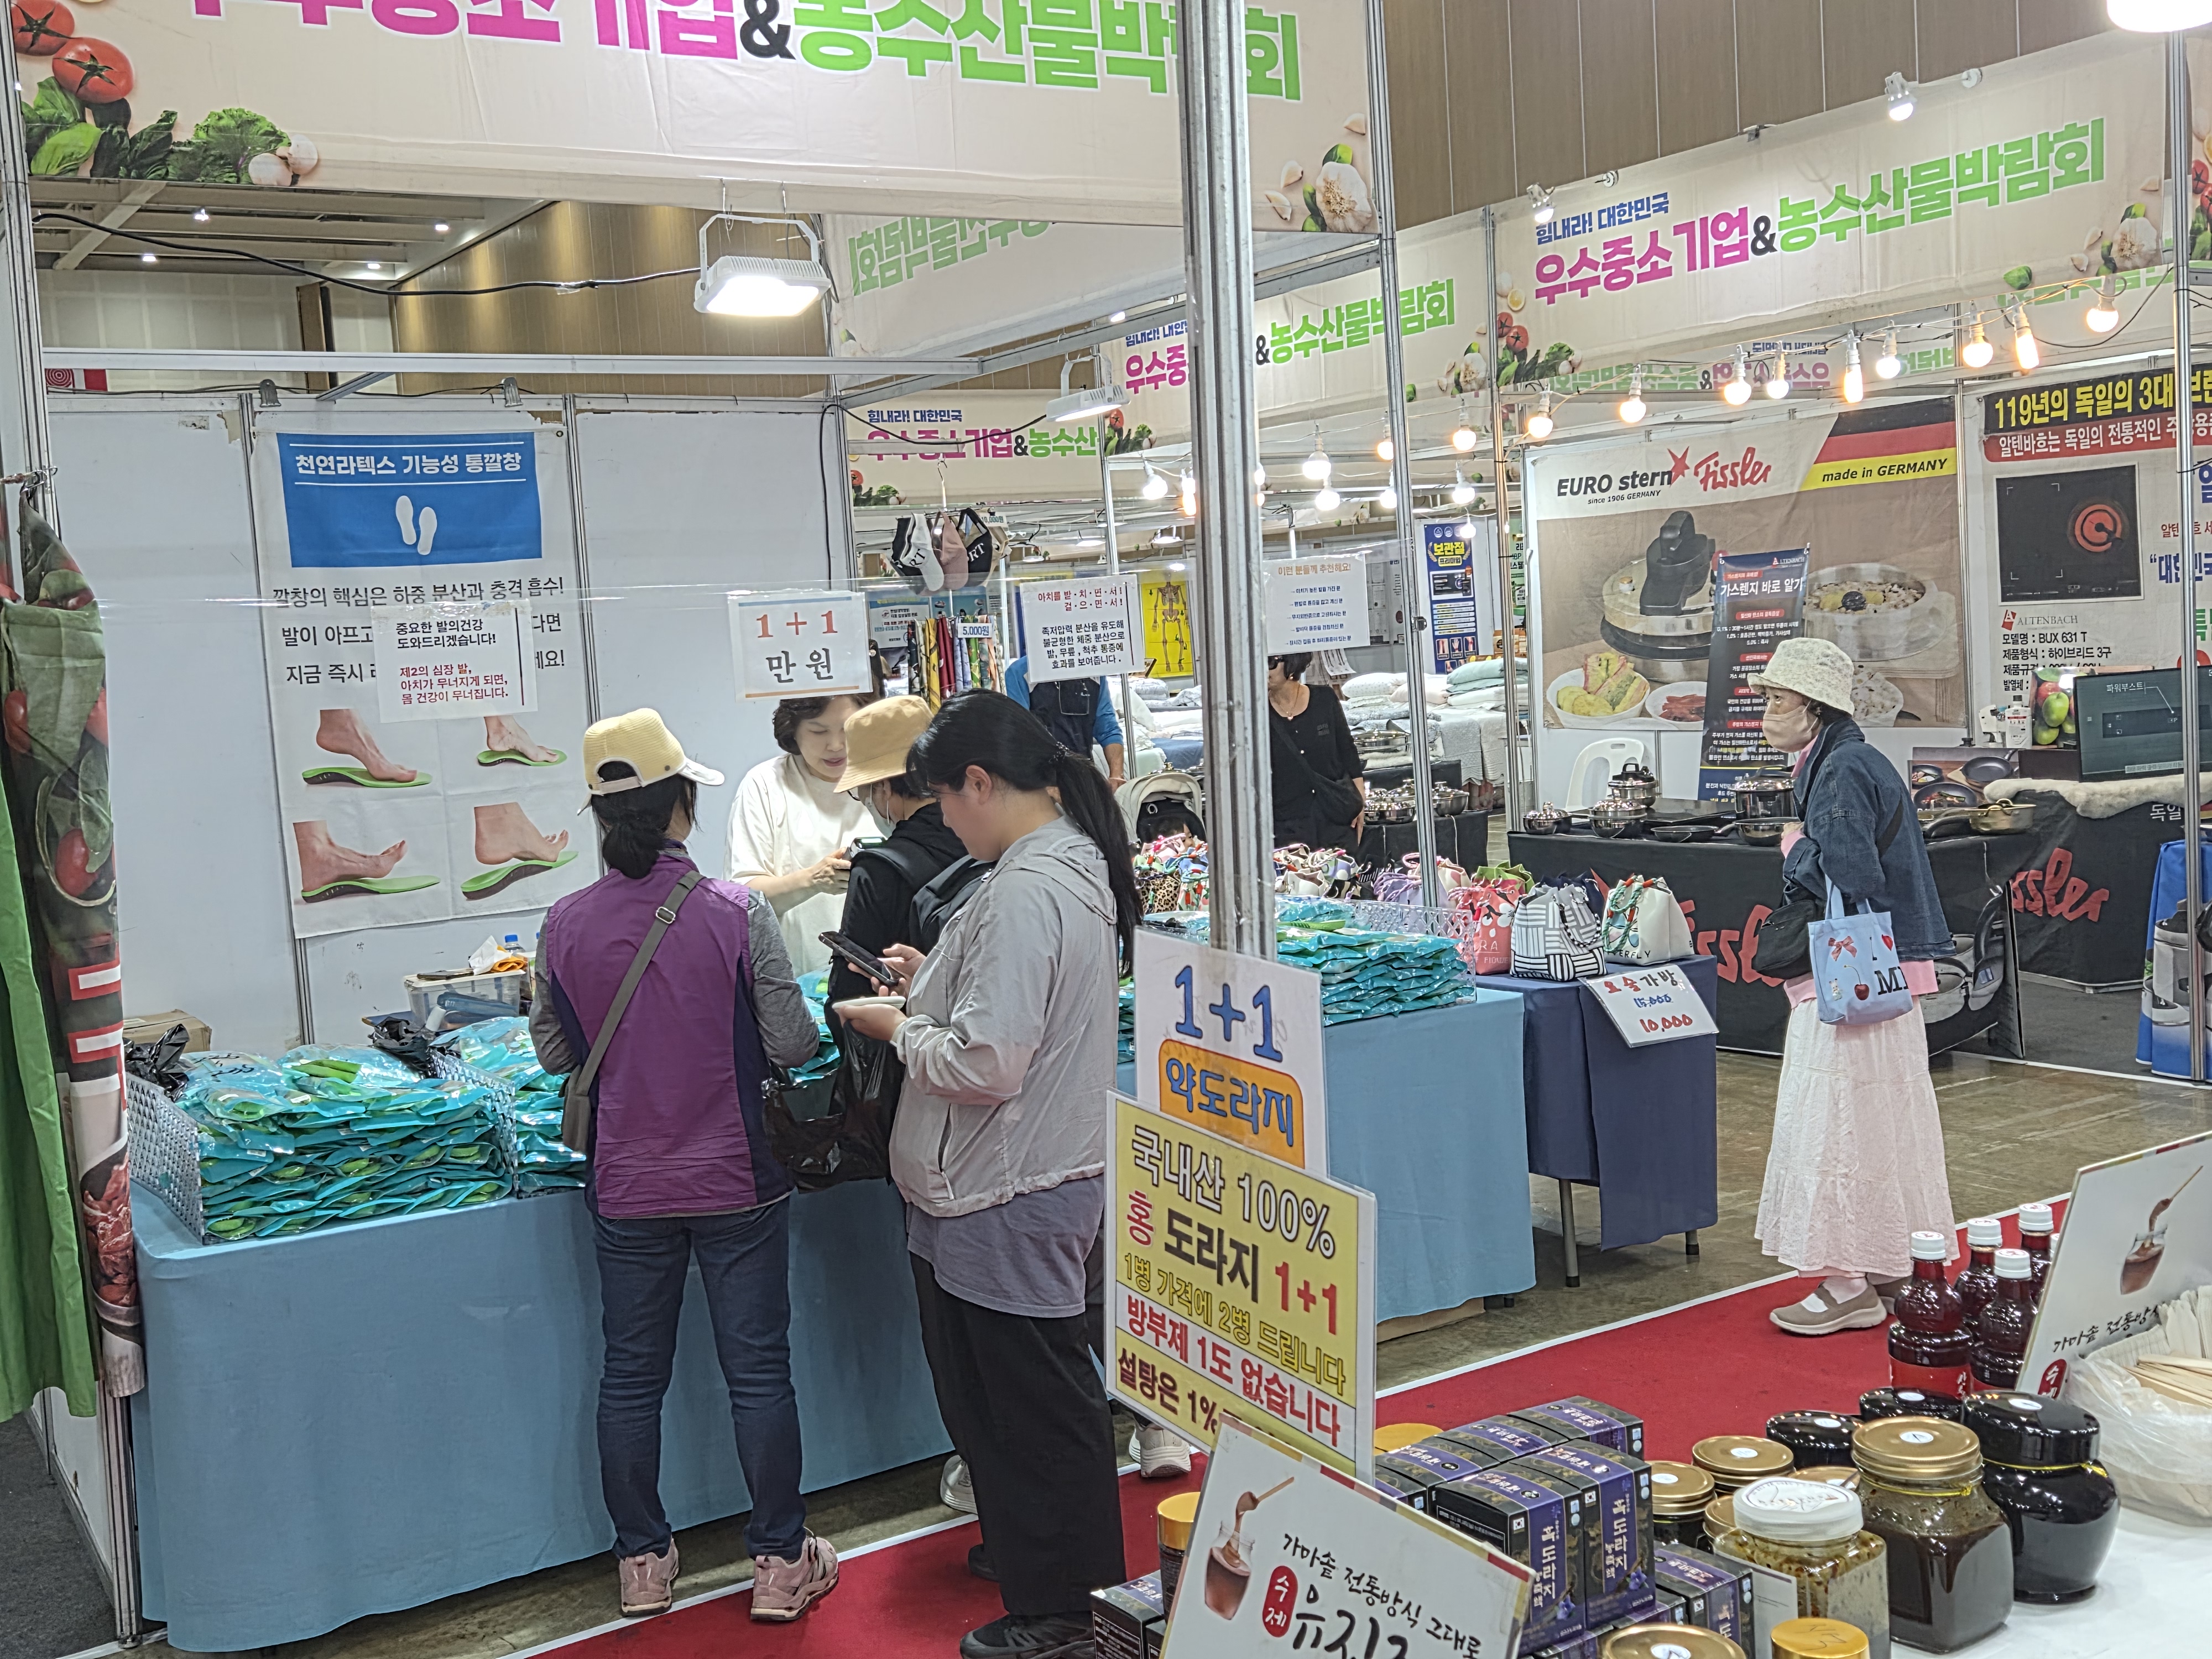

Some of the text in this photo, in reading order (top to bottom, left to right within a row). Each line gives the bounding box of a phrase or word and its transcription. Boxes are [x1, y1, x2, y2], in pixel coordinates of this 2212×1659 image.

[1536, 191, 1669, 245] 힘내라! 대한민국
[1995, 389, 2068, 429] 119년의
[2075, 379, 2132, 418] 독일의
[2140, 373, 2173, 410] 3대
[868, 410, 962, 422] 힘내라! 대한민국
[1999, 432, 2060, 458] 알텐바흐는
[2065, 425, 2104, 450] 독일의
[2109, 418, 2161, 446] 전통적인
[295, 452, 521, 475] 천연라텍스 기능성 통깔창
[1694, 446, 1772, 492] Fissler
[1822, 457, 1948, 483] made in GERMANY
[1557, 470, 1673, 497] EURO stern
[1608, 494, 1625, 503] 1906
[1627, 490, 1661, 500] GERMANY
[1279, 566, 1293, 576] 이런
[273, 577, 564, 608] 깔창의 핵심은 하중 분산과 충격 흡수!
[1038, 591, 1061, 602] 아치를
[1720, 577, 1803, 597] 가스렌지 바로 알기
[396, 622, 432, 636] 중요한
[1042, 620, 1124, 636] 족저압력 분산을 유도해
[2017, 615, 2078, 625] ALTENBACH
[283, 626, 317, 646] 발이
[397, 633, 496, 650] 도와드리겠습니다!
[1044, 632, 1125, 648] 불균형한 체중 분산으로
[2002, 632, 2087, 645] 모델명 BUX 631 T
[1083, 645, 1098, 654] 척추
[1100, 643, 1123, 653] 통증에
[2003, 647, 2111, 660] 제품형식 하이브리드 3구
[400, 663, 472, 677] 제2의 심장 발,
[1052, 659, 1075, 669] 효과를
[286, 664, 363, 685] 지금 즉시
[401, 674, 508, 691] 아치가 무너지게 되면,
[2004, 680, 2023, 691] 발열체
[2106, 681, 2144, 693] 파워부스트
[401, 688, 509, 705] 몸 건강이 무너집니다.
[2150, 804, 2182, 822] 독일
[2009, 848, 2109, 922] ssler
[1175, 965, 1283, 1062] 1+1
[1640, 1014, 1693, 1032] 10,000
[1166, 1058, 1293, 1147] 약도라지
[1131, 1124, 1336, 1259] 국내산 100%
[1126, 1190, 1338, 1336] 홍 도라지 1+1
[1124, 1253, 1346, 1395] 1병 가격에 2병 드립니다
[1126, 1295, 1340, 1448] 방부제 1도 없습니다
[1118, 1347, 1218, 1434] 설탕은 1%
[1344, 1567, 1422, 1628] 전통방식
[1426, 1617, 1482, 1659] 그대로
